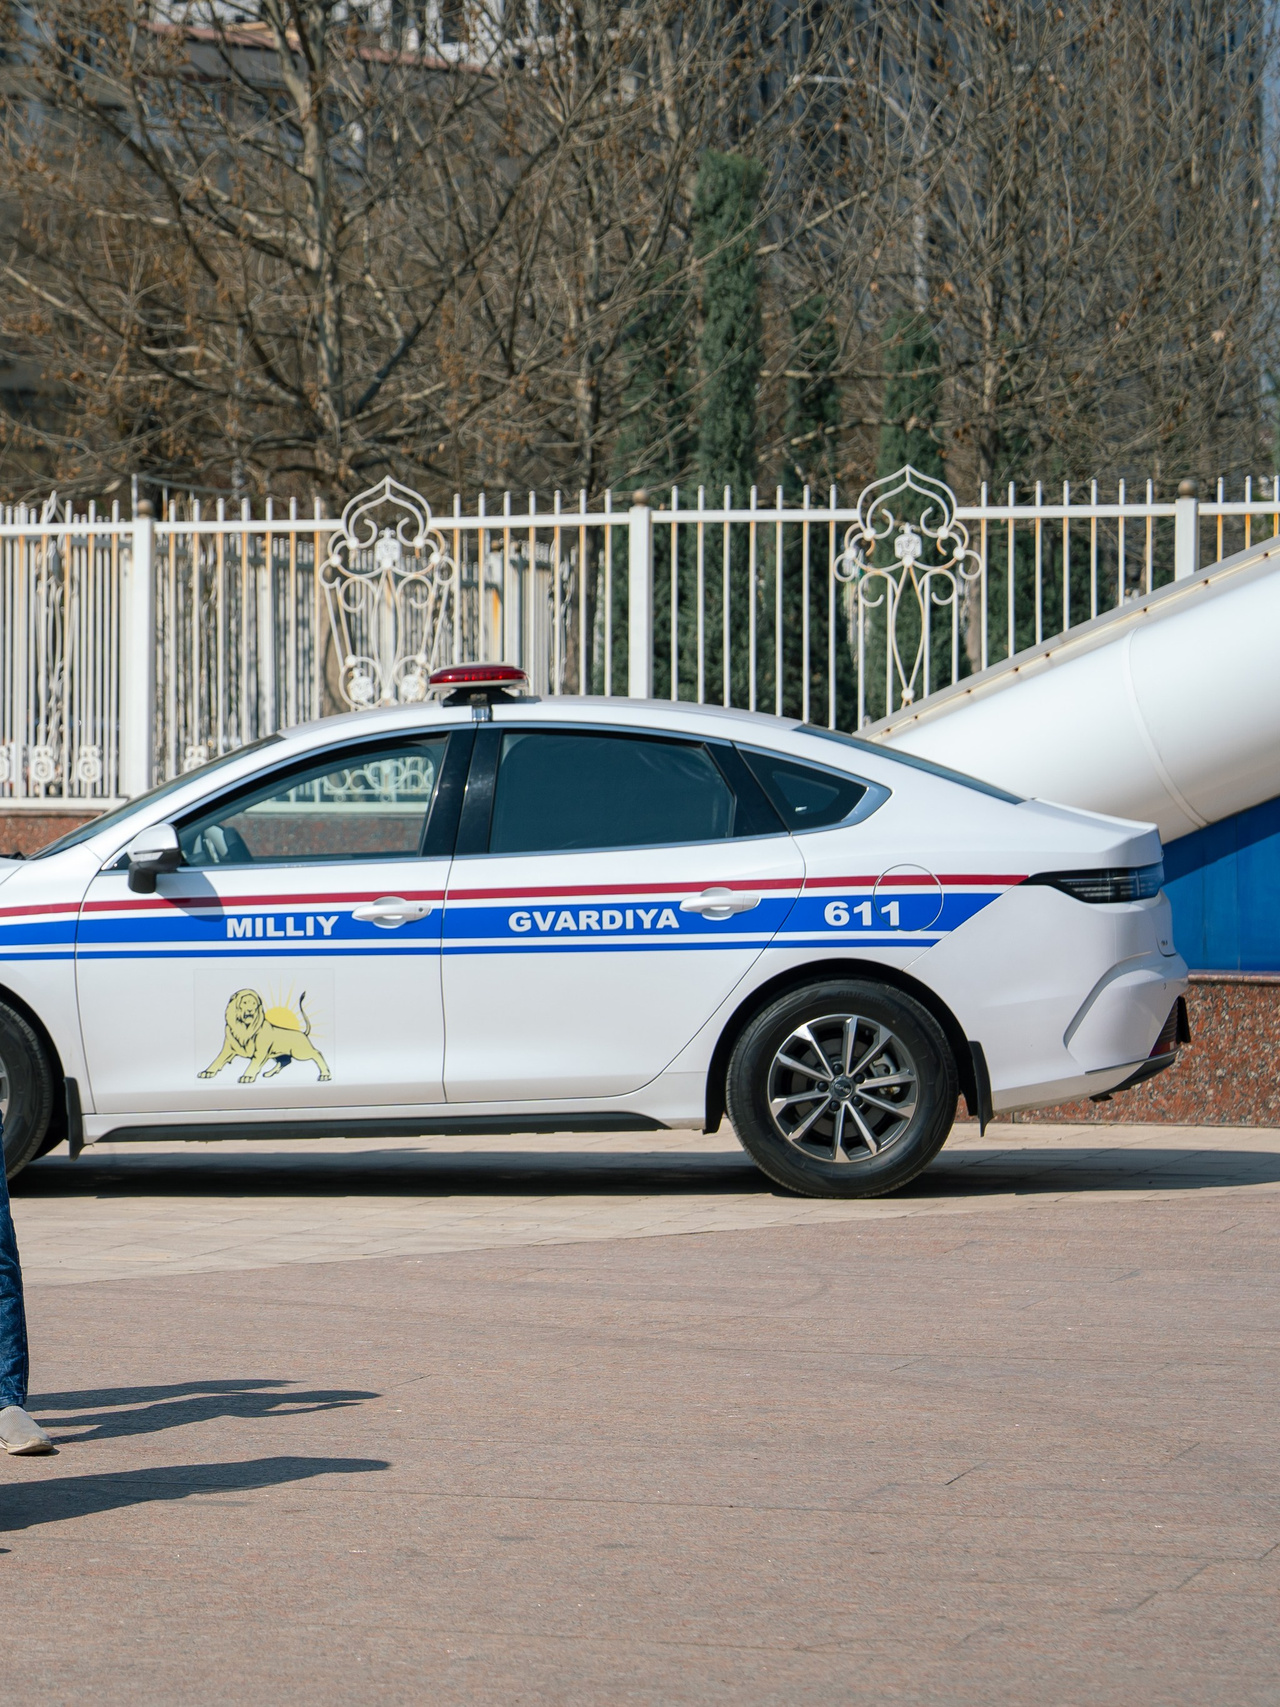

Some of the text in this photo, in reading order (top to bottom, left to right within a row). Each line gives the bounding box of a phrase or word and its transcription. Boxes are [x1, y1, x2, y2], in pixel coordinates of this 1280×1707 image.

[226, 901, 900, 938] MILLIY GVARDIYA 611
